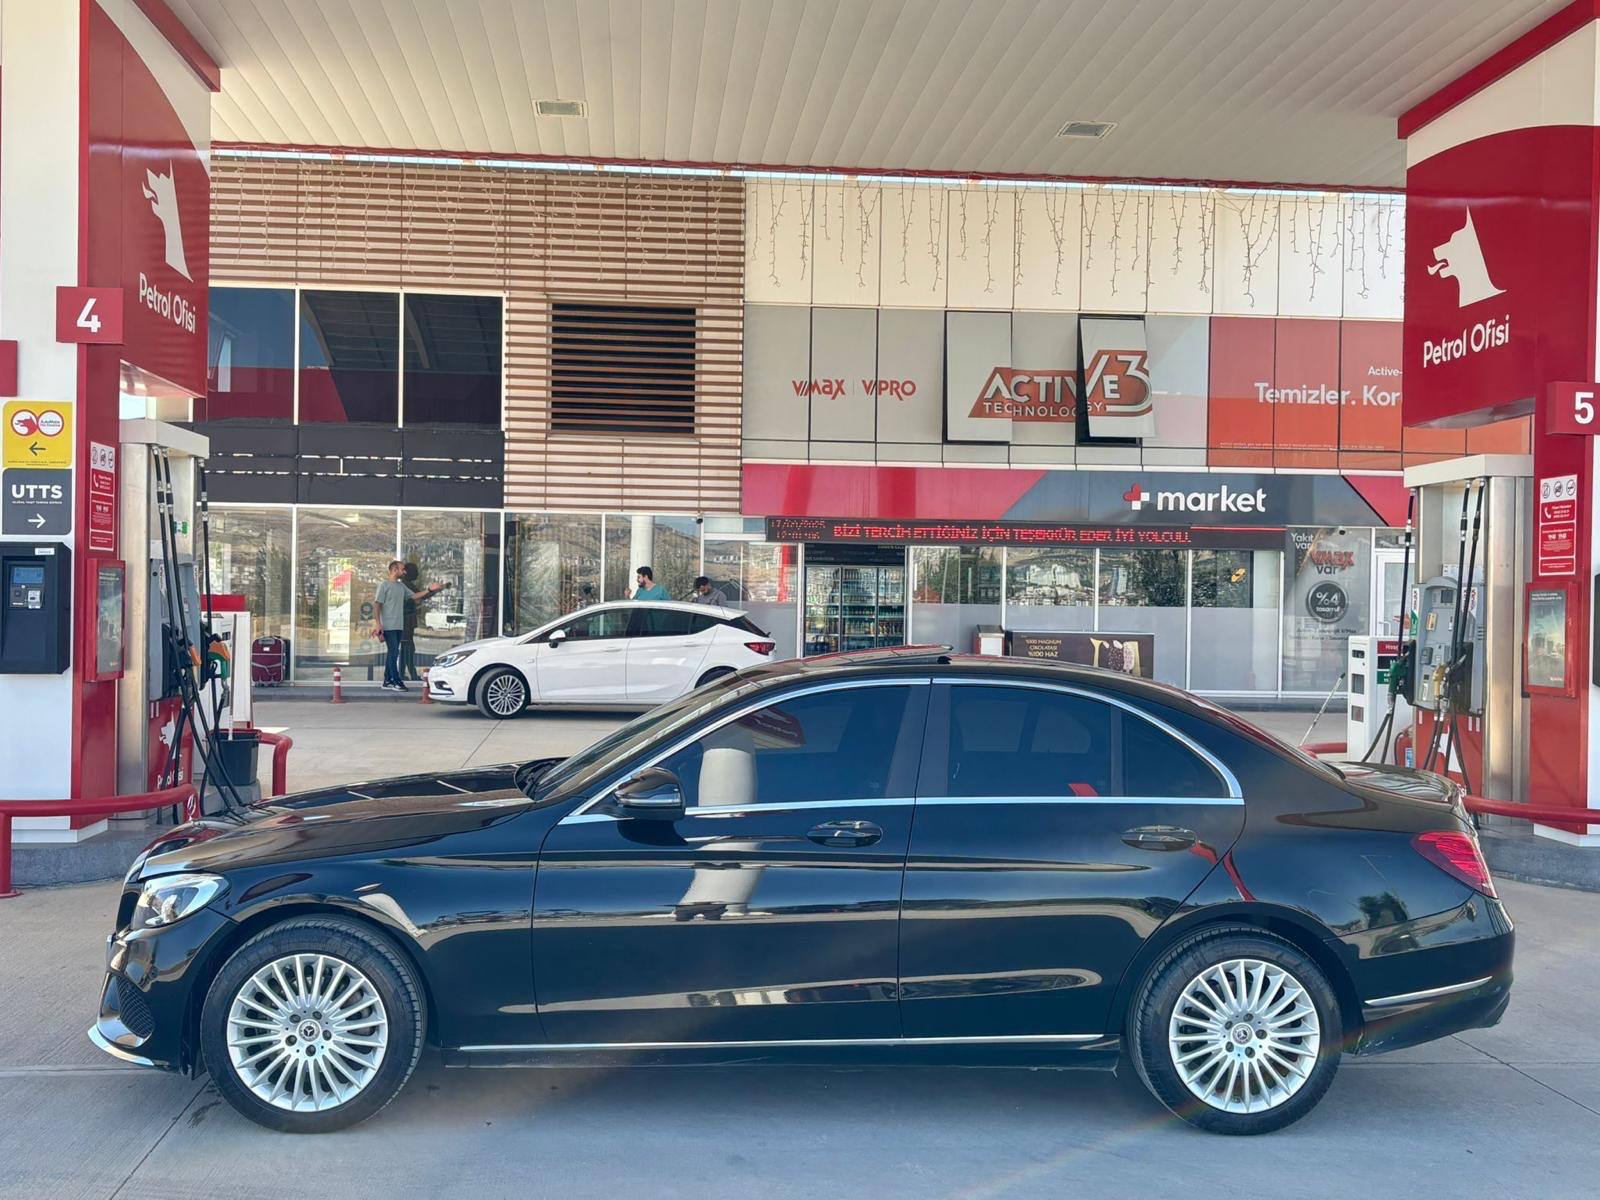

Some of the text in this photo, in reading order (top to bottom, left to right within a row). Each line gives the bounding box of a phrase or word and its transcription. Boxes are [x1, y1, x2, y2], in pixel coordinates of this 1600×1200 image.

[76, 298, 101, 333] 4
[139, 272, 196, 335] Petrol Ofisi
[1423, 314, 1510, 368] Petrol Ofisi
[1254, 382, 1357, 406] Temizler.
[1574, 391, 1595, 425] 5
[983, 402, 1103, 418] TECHNOLOGY
[11, 484, 63, 499] UTTS
[1157, 485, 1267, 513] market
[1316, 565, 1337, 574] var
